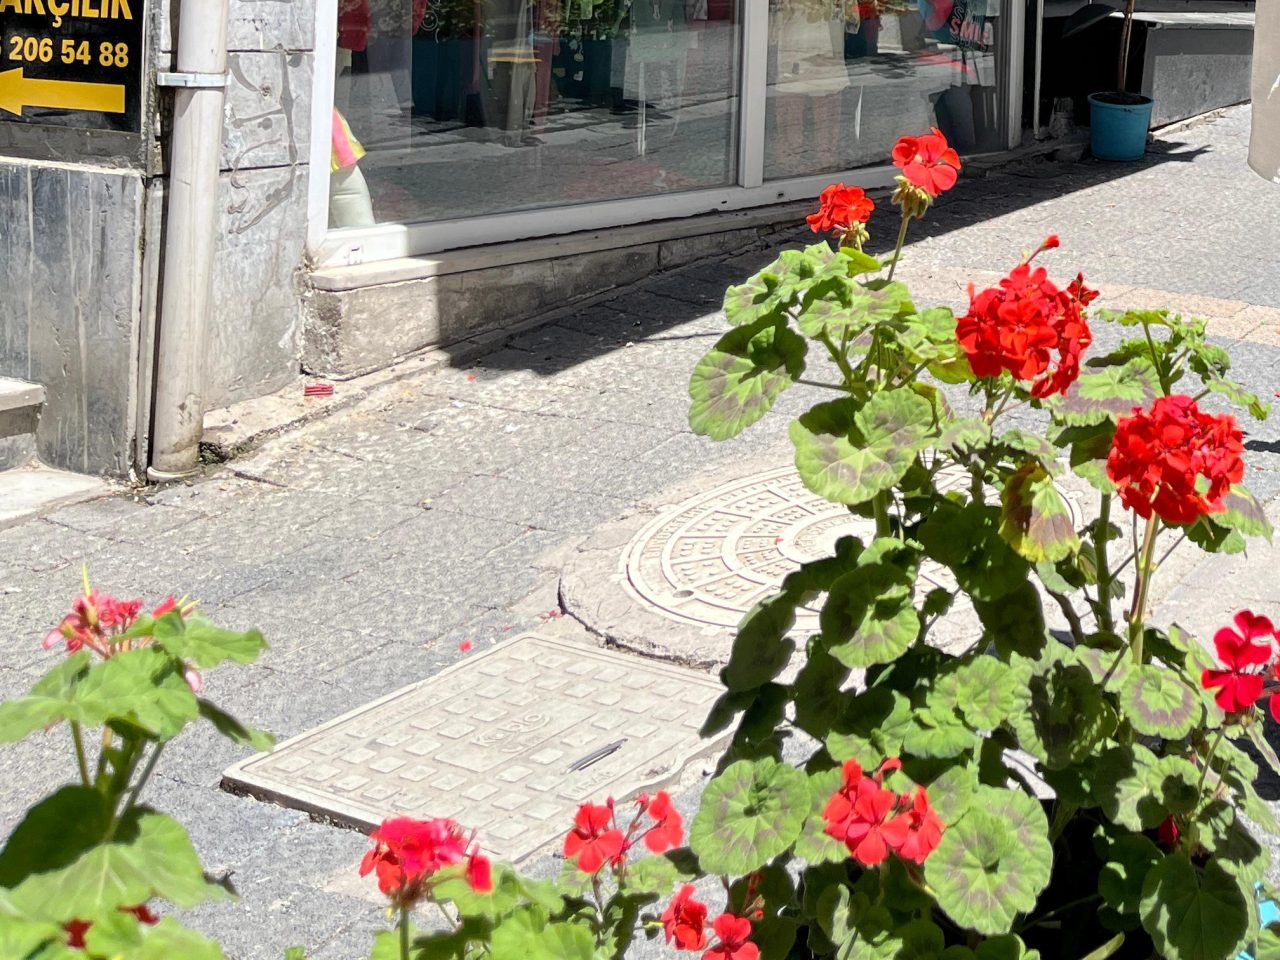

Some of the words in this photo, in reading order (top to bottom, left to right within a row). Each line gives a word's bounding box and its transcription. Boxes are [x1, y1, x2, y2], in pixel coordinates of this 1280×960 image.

[8, 35, 53, 63] 206
[61, 39, 92, 65] 54
[99, 41, 129, 68] 88
